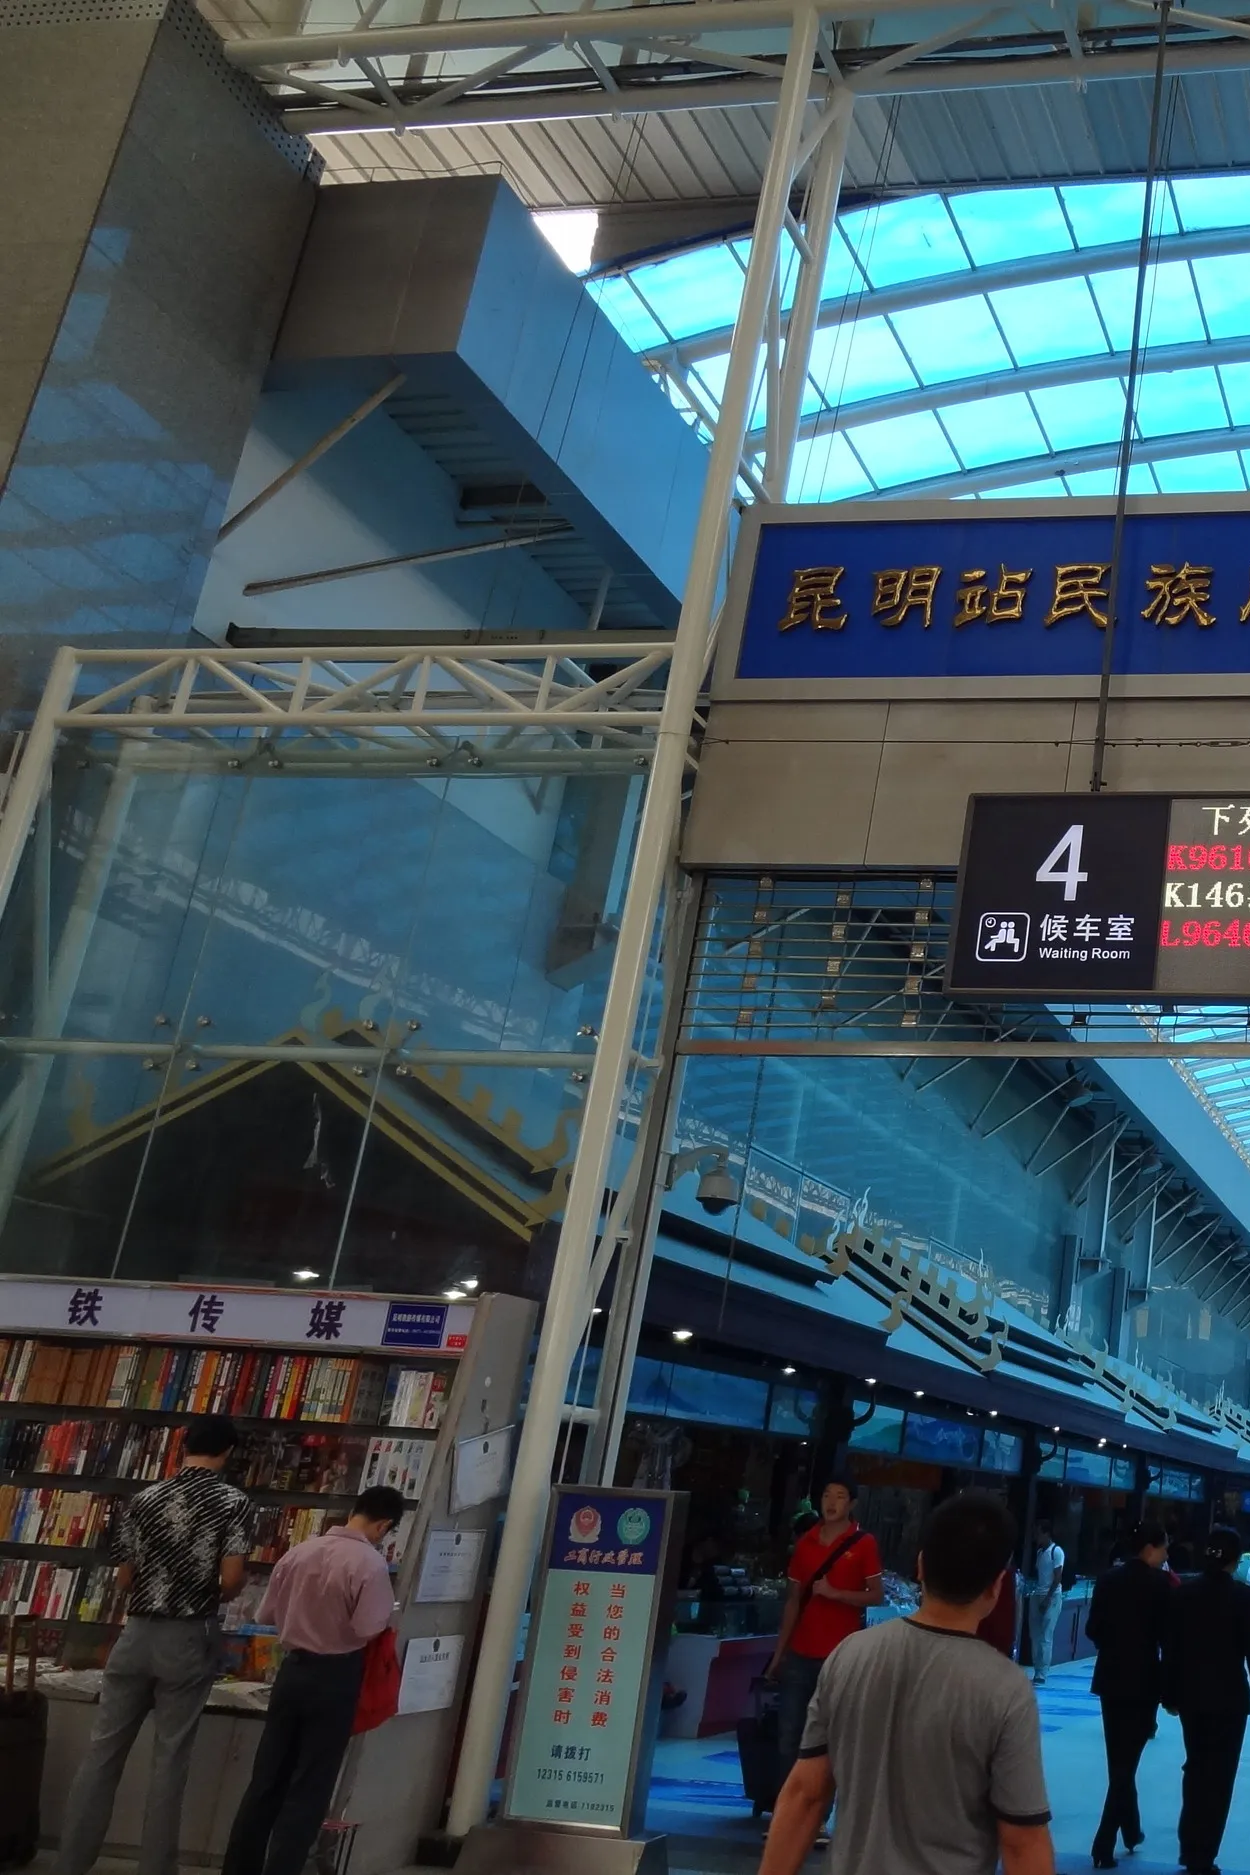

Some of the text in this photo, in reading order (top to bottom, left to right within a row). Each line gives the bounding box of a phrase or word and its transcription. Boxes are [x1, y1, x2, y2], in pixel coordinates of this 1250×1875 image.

[1035, 824, 1089, 901] 4
[1039, 913, 1135, 942] 候车室
[1039, 947, 1131, 961] Waiting Room
[553, 1581, 591, 1725] 权益受到侵害时
[590, 1583, 627, 1728] 当您的合法消费
[551, 1744, 591, 1761] 请拨打
[537, 1768, 604, 1784] 12315 6159571
